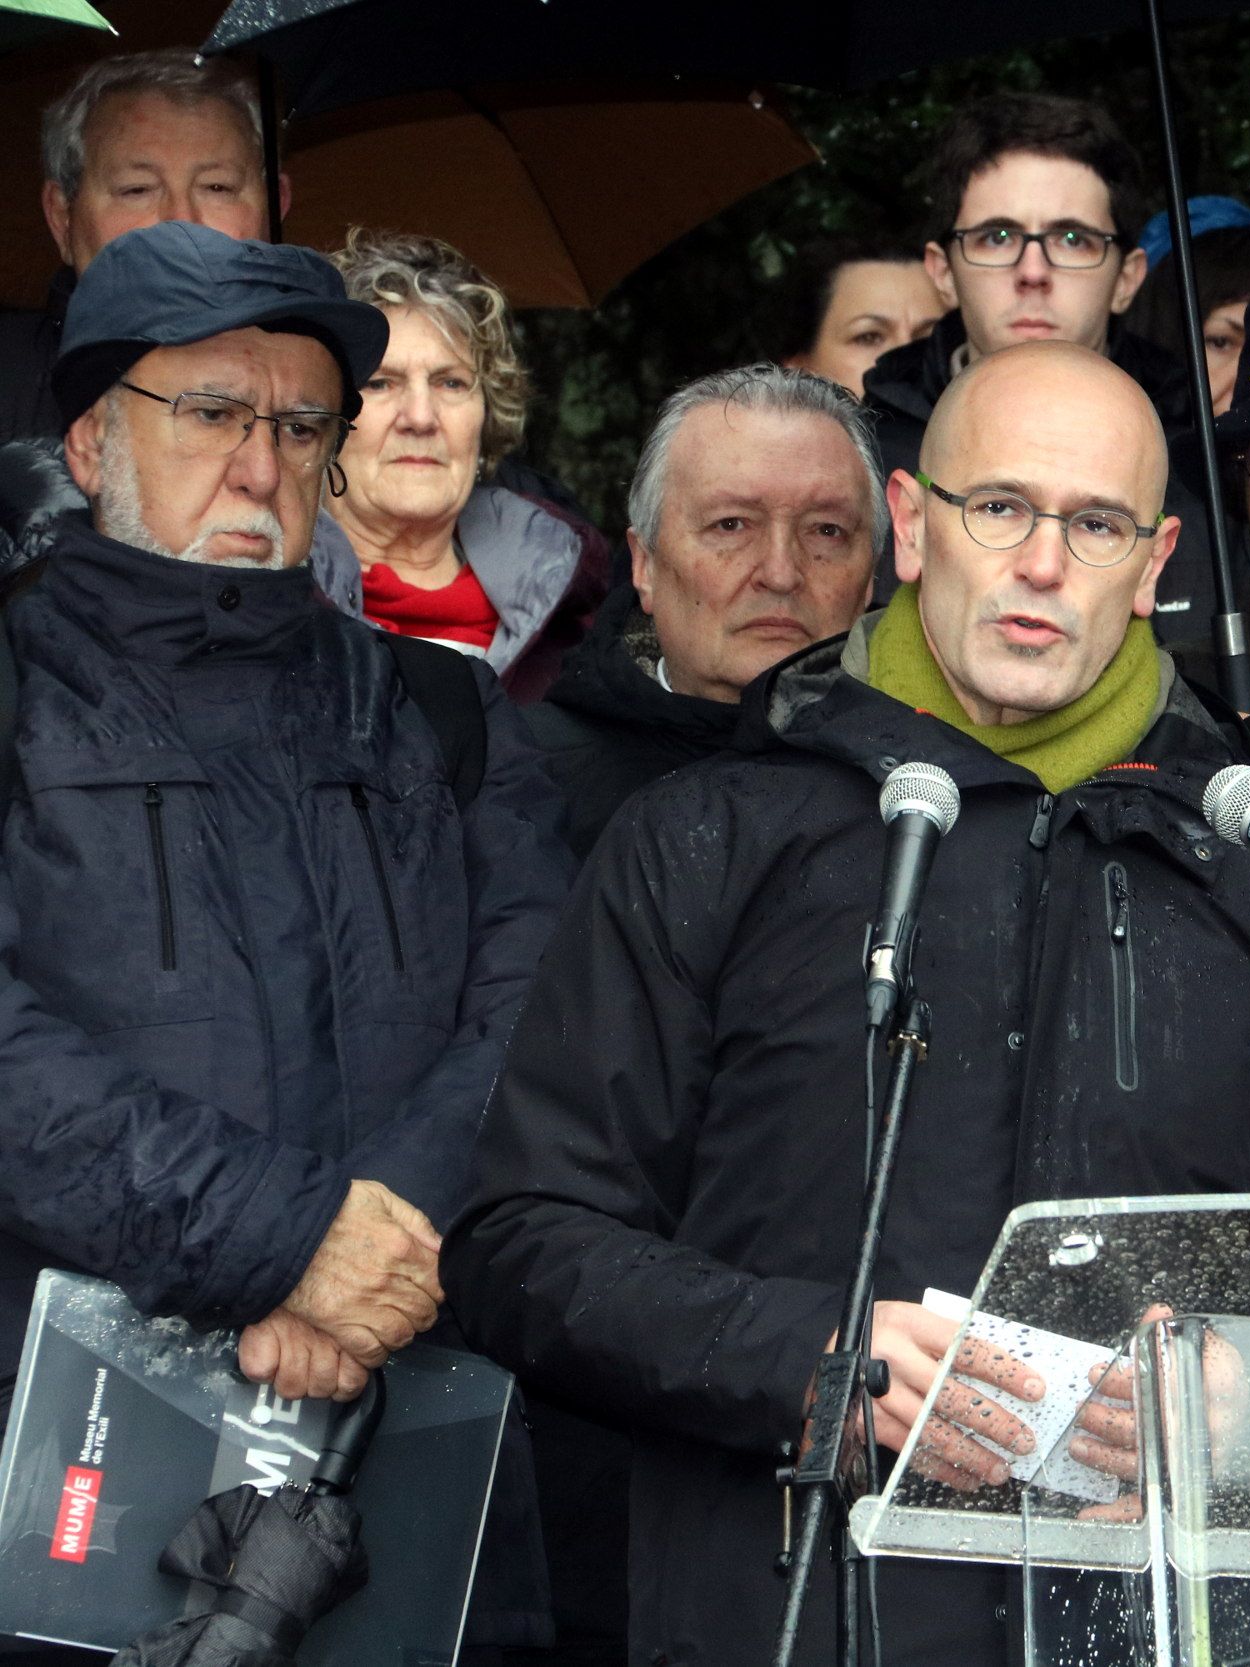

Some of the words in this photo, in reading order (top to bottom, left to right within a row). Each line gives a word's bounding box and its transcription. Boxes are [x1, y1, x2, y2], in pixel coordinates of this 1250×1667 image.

[87, 1368, 107, 1421] Memorial
[79, 1423, 97, 1462] Museu
[92, 1449, 103, 1464] de
